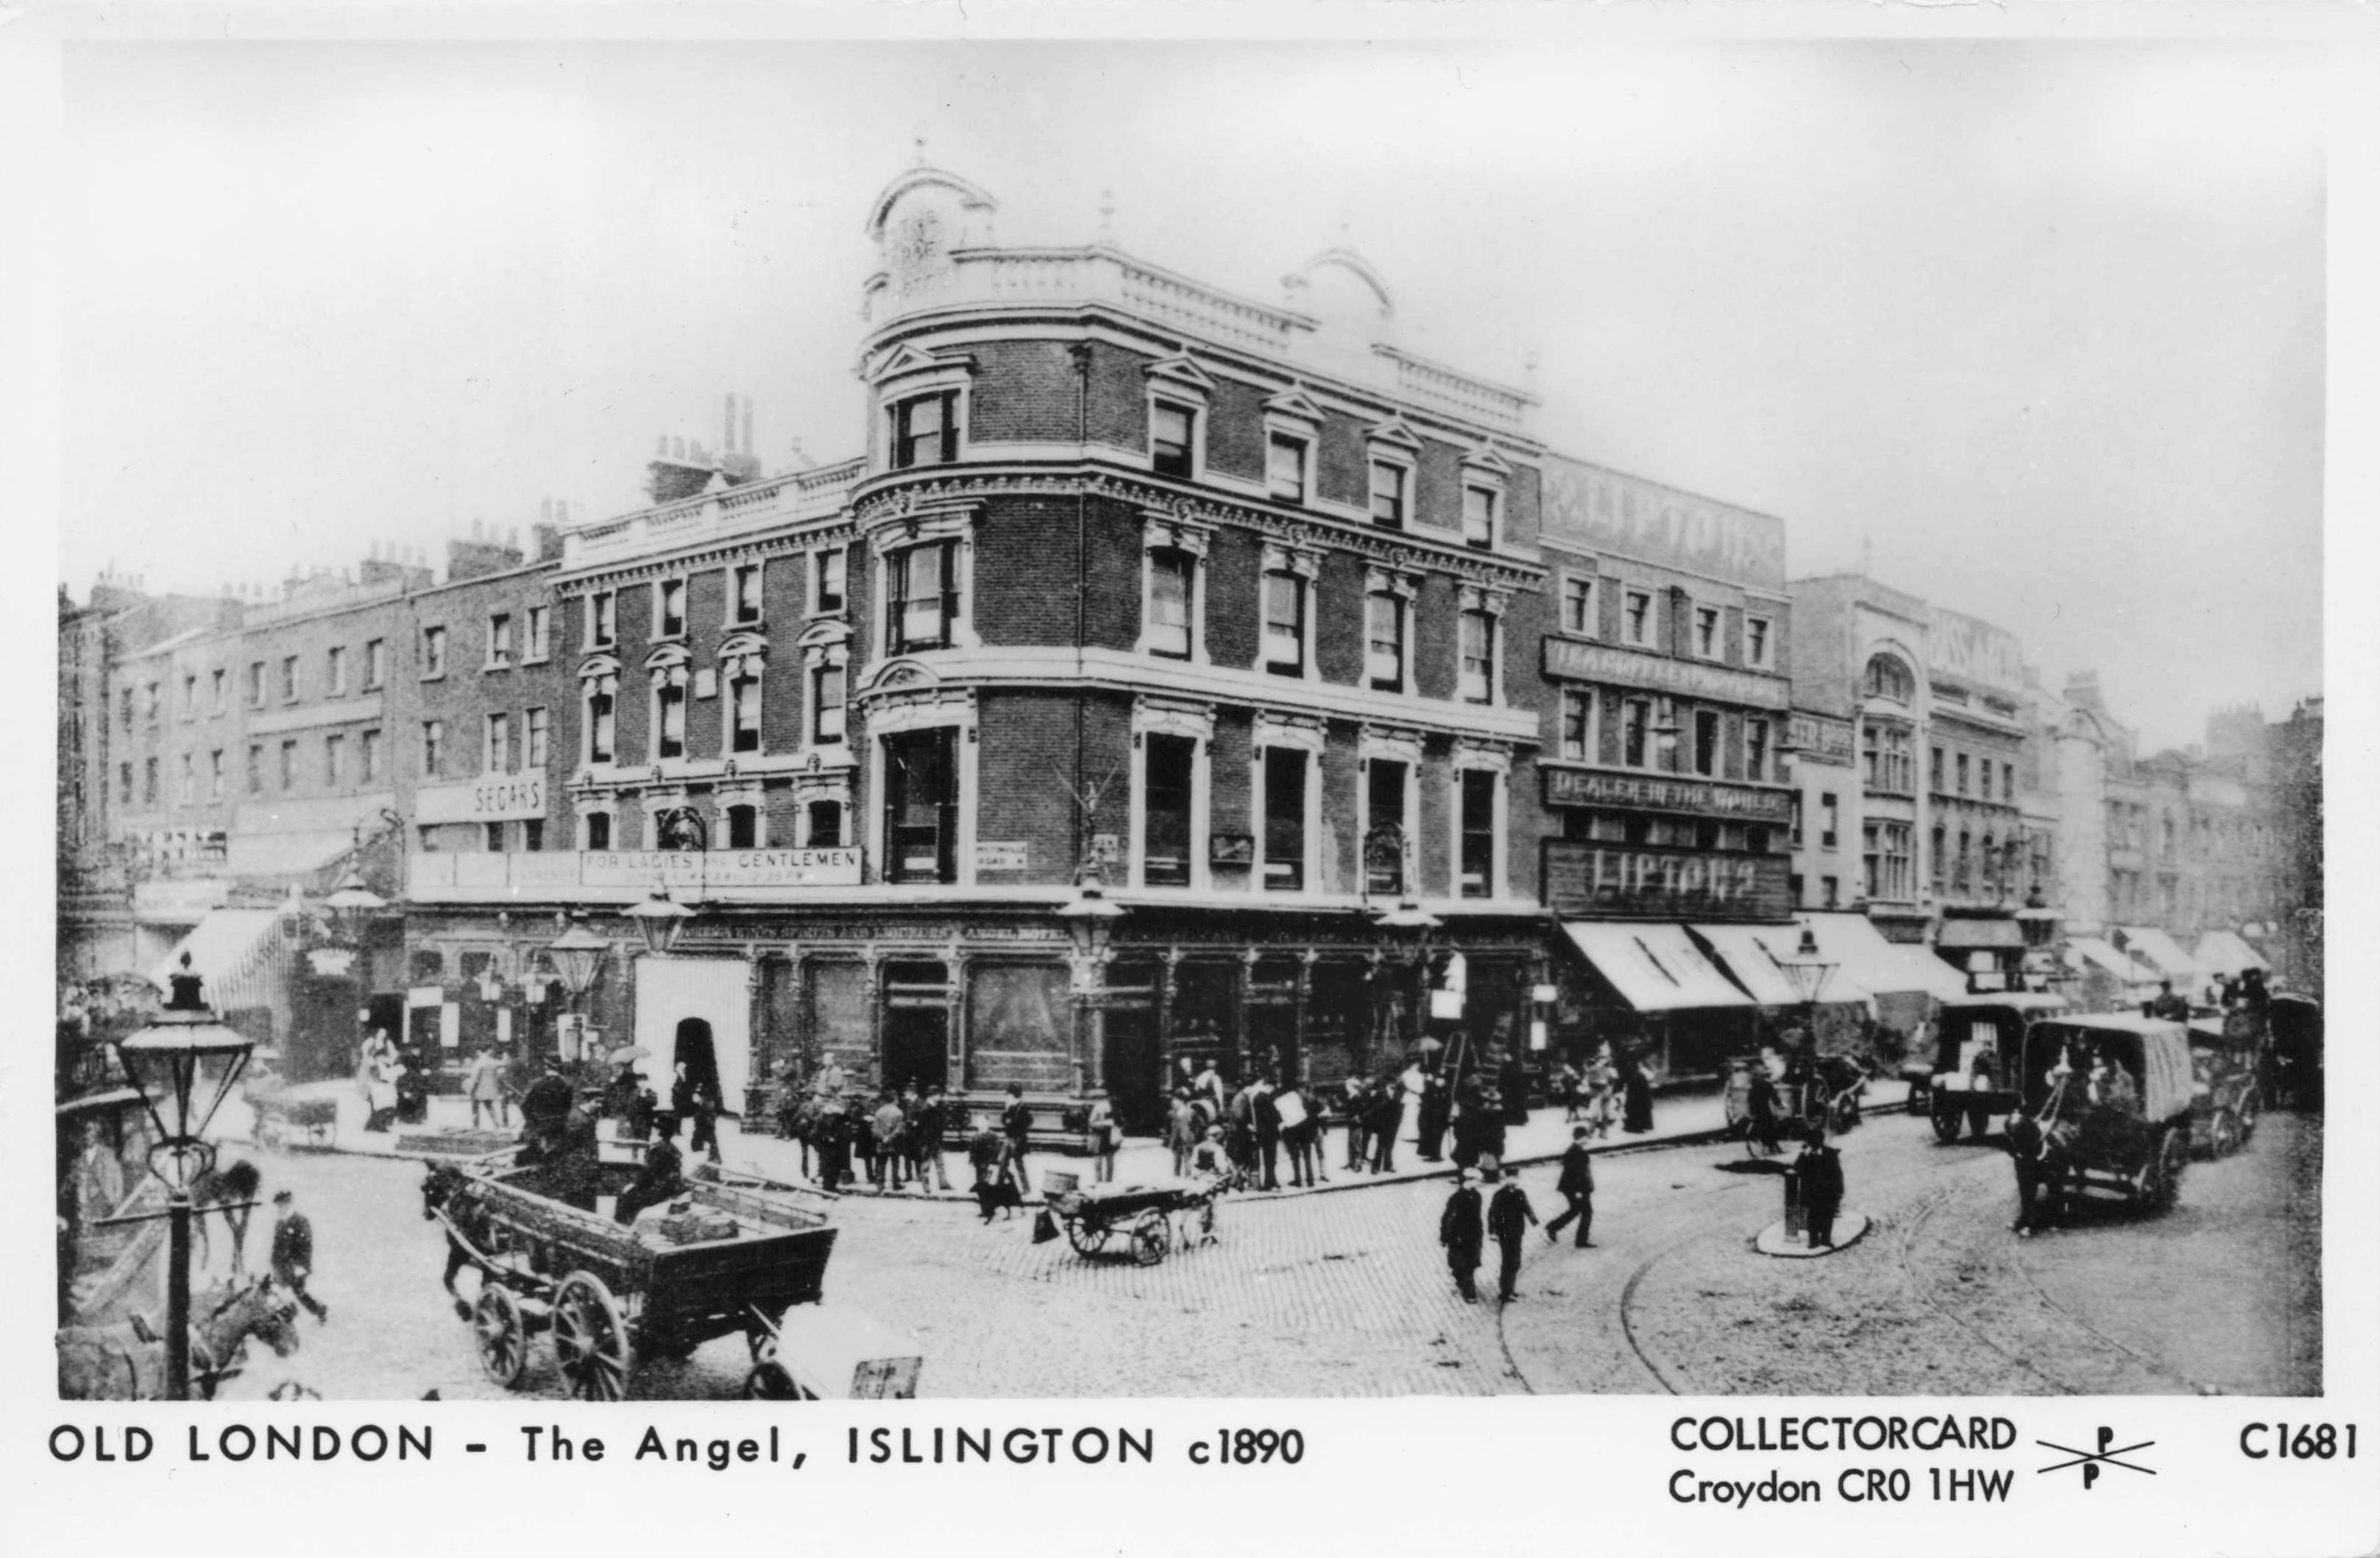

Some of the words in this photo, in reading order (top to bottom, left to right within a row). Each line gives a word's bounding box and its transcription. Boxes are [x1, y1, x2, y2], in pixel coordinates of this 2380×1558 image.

[1556, 770, 1639, 802] DEALER
[587, 855, 619, 868] FOR
[628, 854, 693, 868] LADIES
[738, 851, 856, 868] GENTLEMEN
